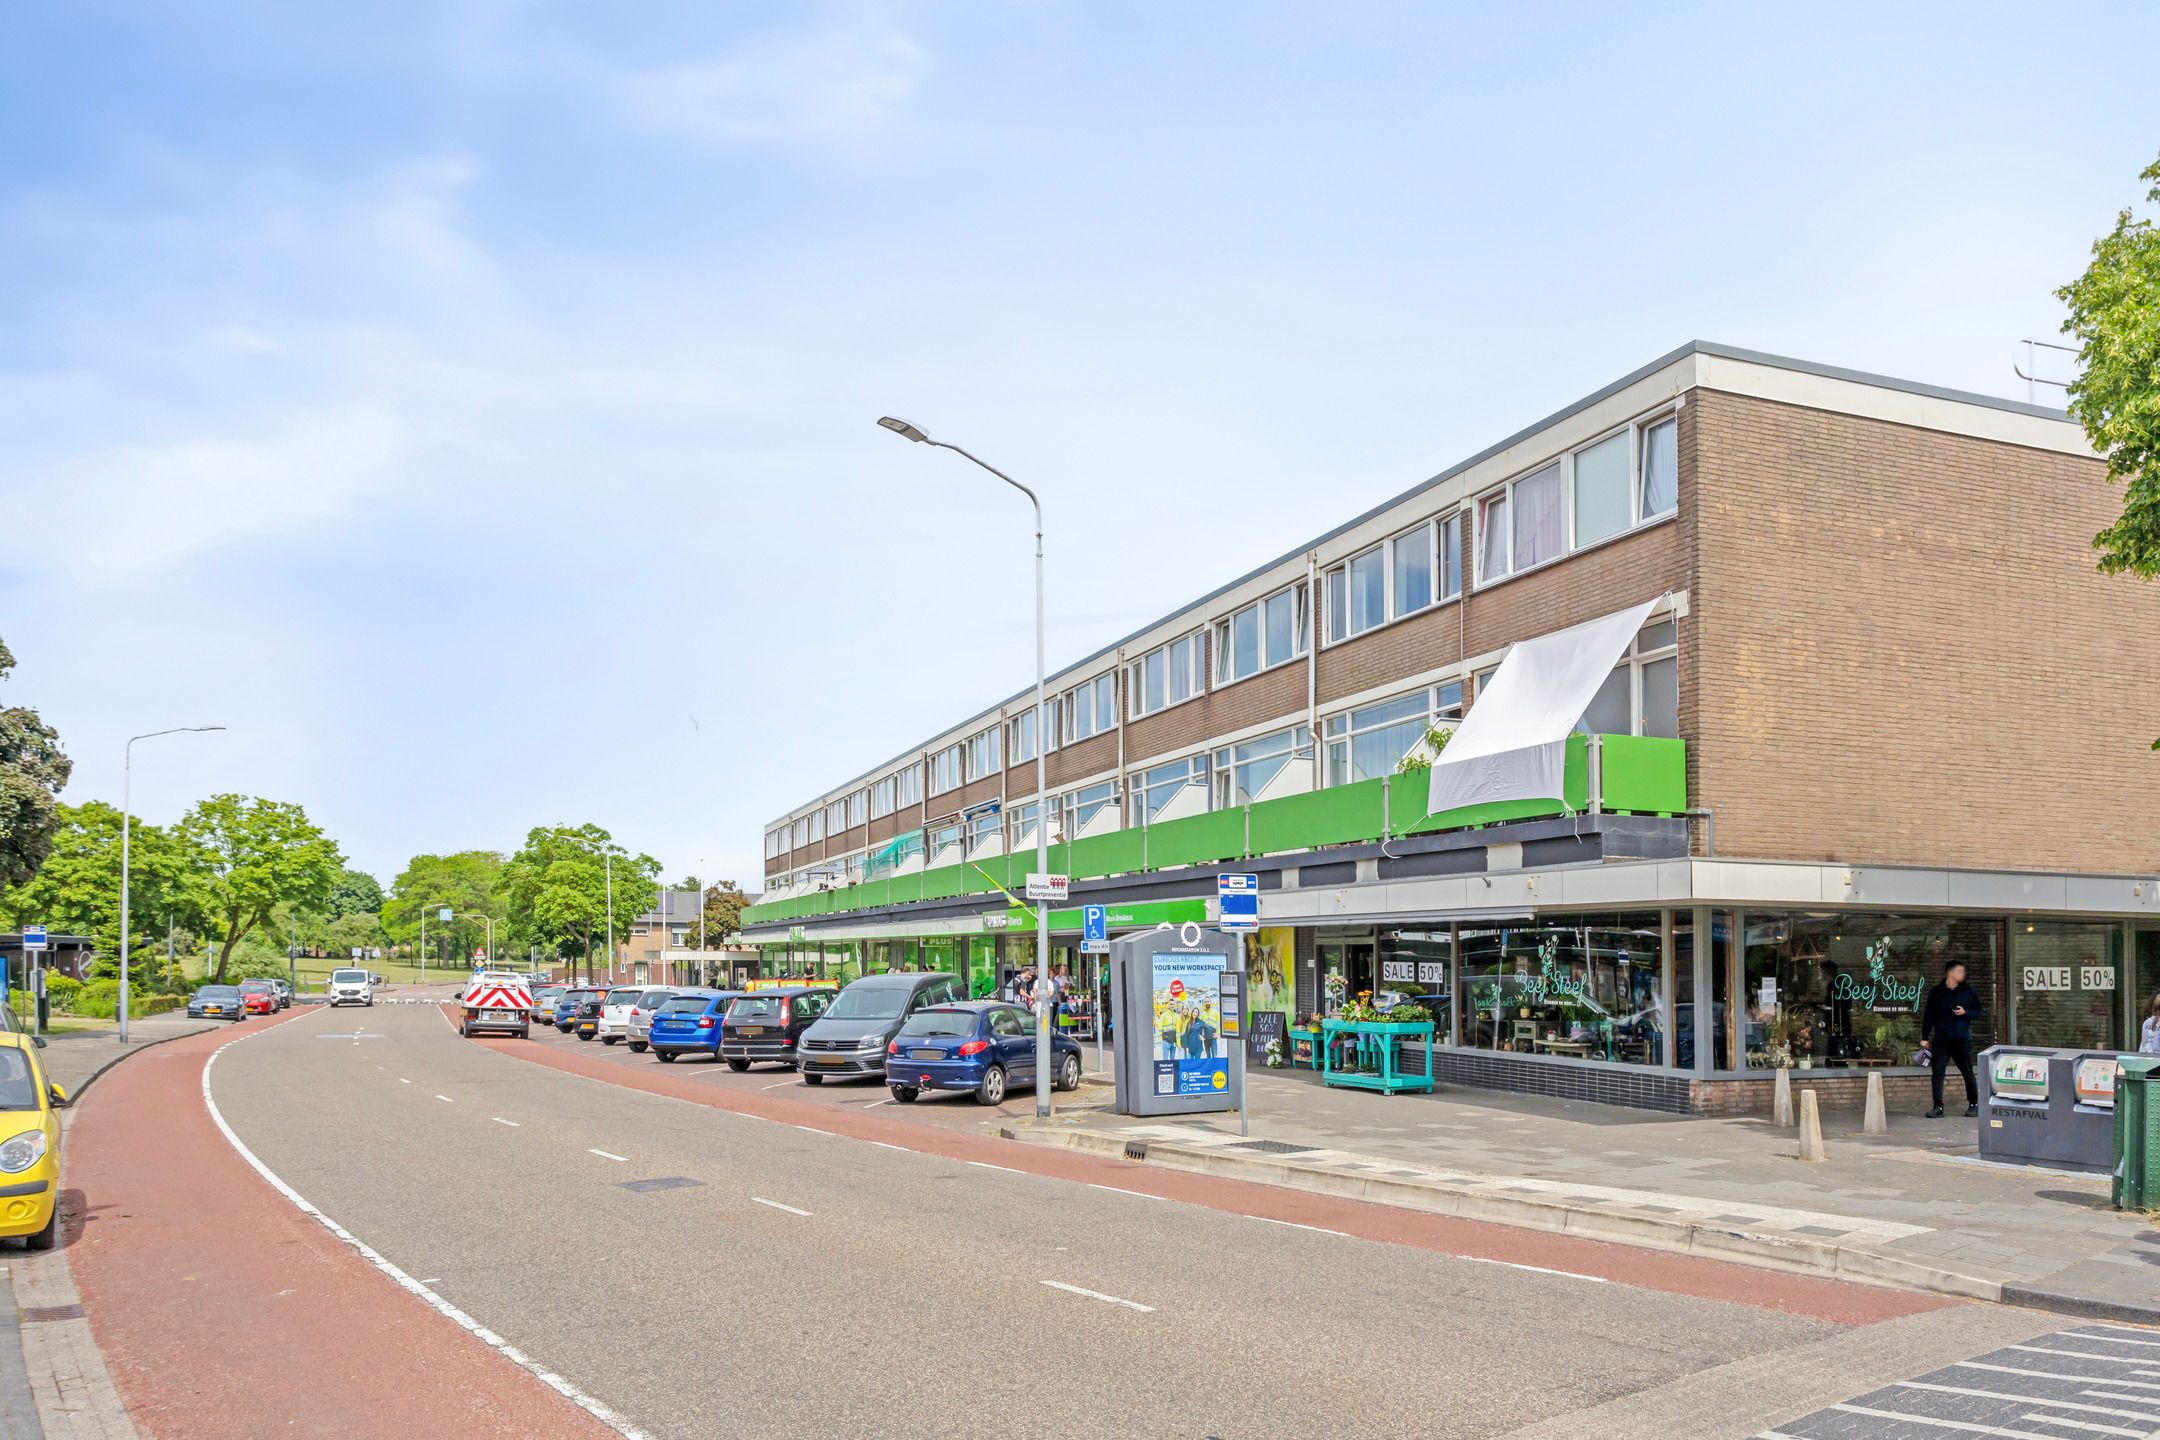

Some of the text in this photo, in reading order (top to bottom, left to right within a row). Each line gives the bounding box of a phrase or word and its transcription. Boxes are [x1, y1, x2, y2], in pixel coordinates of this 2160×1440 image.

[1088, 908, 1100, 925] P
[1384, 964, 1442, 980] SALE 50%
[2025, 970, 2113, 987] SALE 50%
[1551, 971, 1588, 1007] Steef
[1881, 974, 1925, 1013] Steef
[1258, 1014, 1278, 1024] SALE
[1260, 1024, 1274, 1032] 50%
[1991, 1107, 2049, 1120] RESTAFVAL
